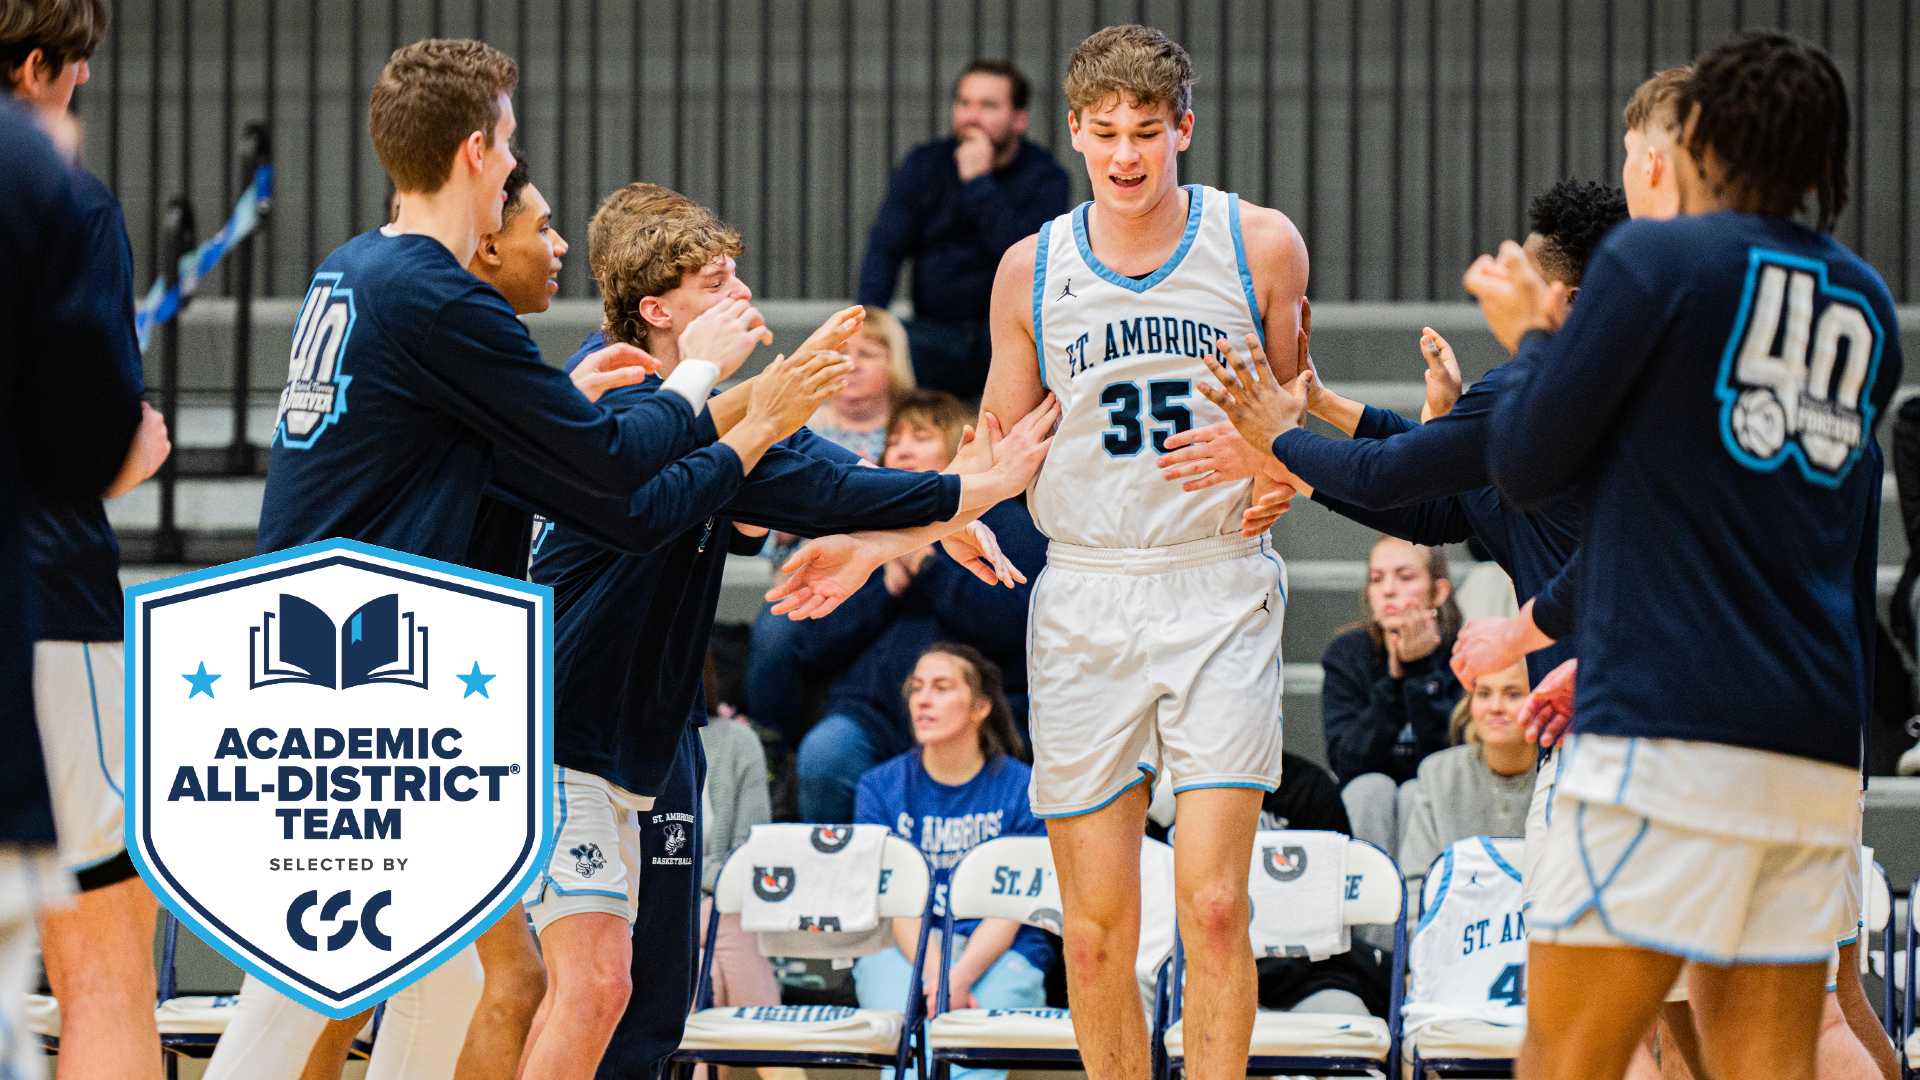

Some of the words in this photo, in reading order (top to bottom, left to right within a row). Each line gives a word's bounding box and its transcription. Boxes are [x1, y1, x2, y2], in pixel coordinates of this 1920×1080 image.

[1066, 331, 1095, 378] ST.
[1099, 378, 1195, 458] 35
[652, 814, 664, 824] ST.
[666, 812, 694, 823] AMBROSE
[652, 857, 692, 865] BASKETBALL
[1463, 918, 1491, 955] ST.
